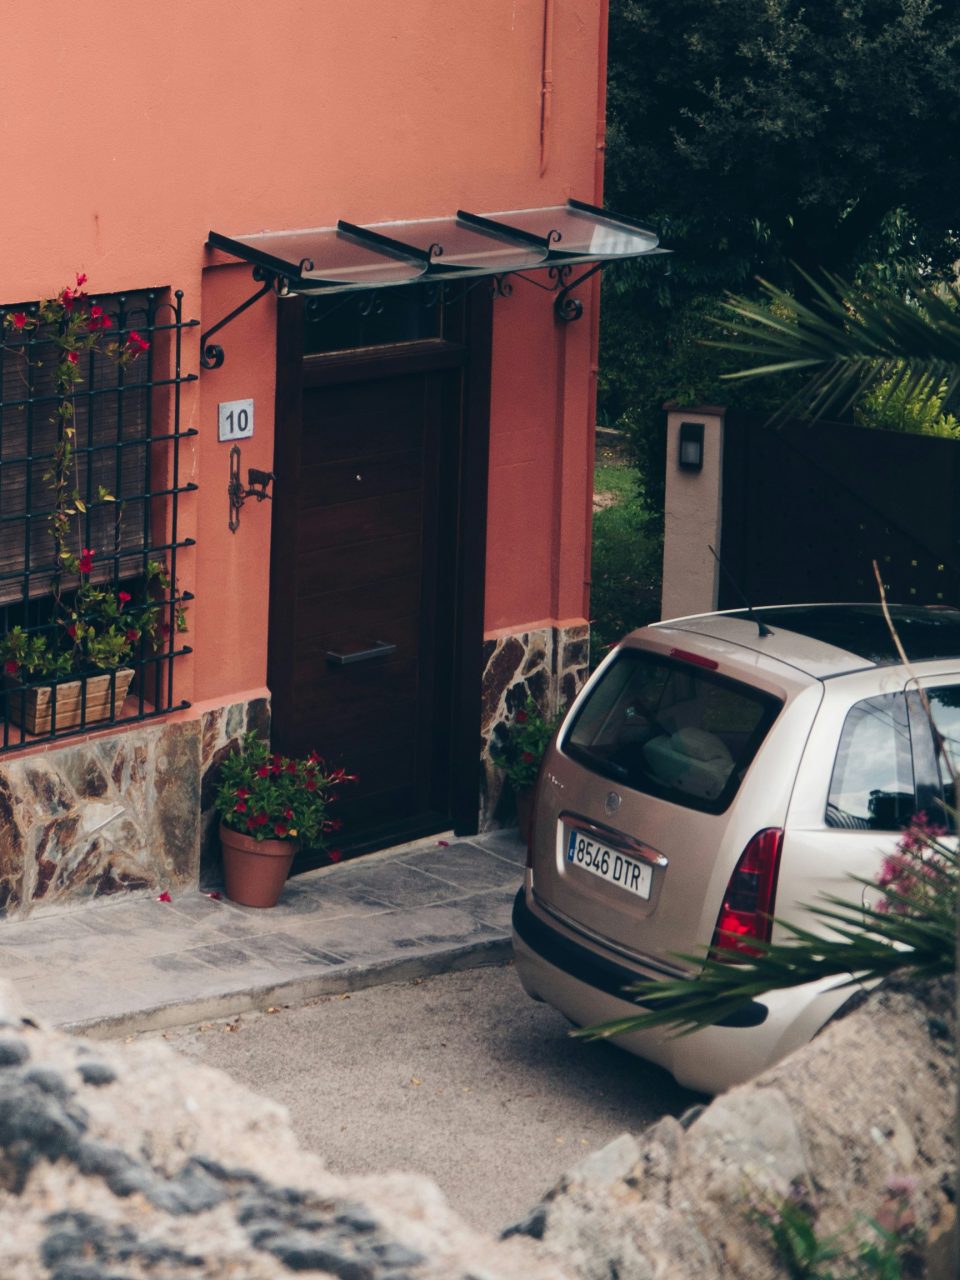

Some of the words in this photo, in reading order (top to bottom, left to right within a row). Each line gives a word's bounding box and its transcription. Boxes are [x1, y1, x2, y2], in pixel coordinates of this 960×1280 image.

[226, 409, 248, 434] 10
[577, 839, 610, 874] 8546
[613, 856, 640, 890] DTR
